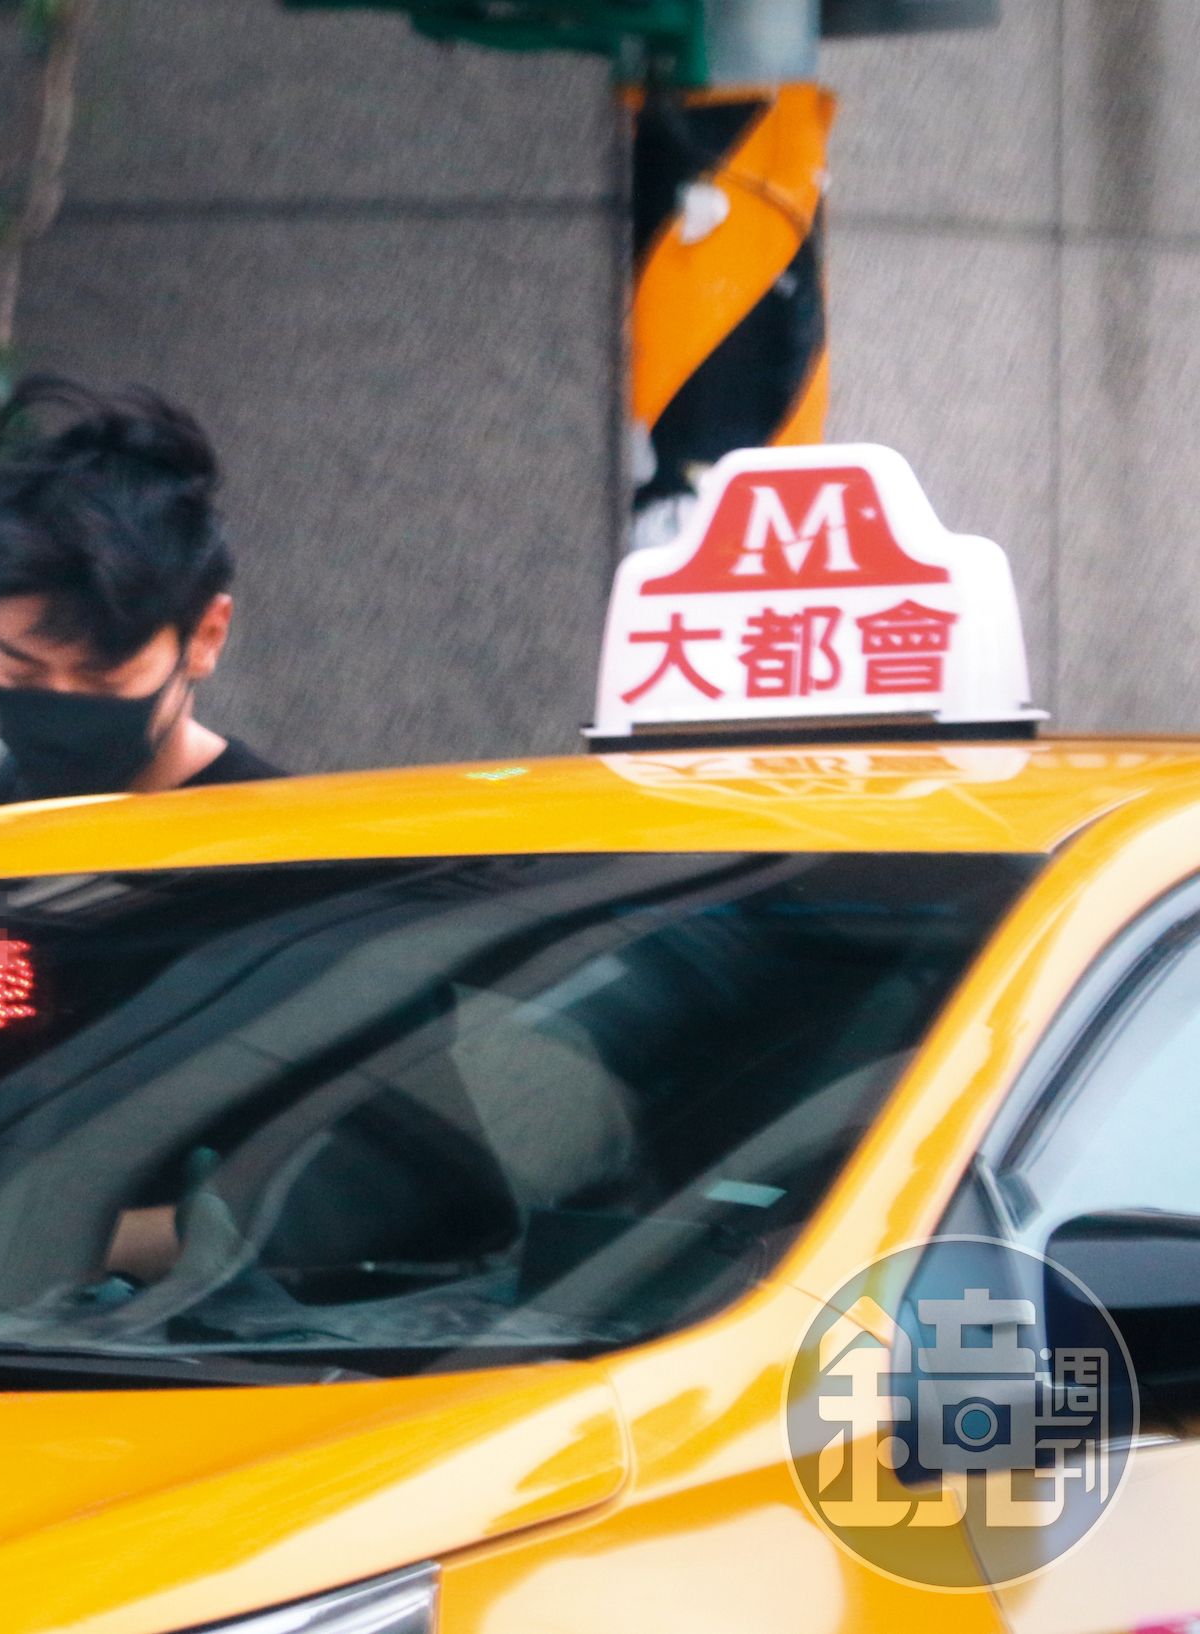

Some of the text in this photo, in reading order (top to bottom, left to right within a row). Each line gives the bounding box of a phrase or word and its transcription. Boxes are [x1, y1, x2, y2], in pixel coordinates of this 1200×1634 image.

[730, 482, 860, 576] M
[620, 600, 960, 705] 大都會
